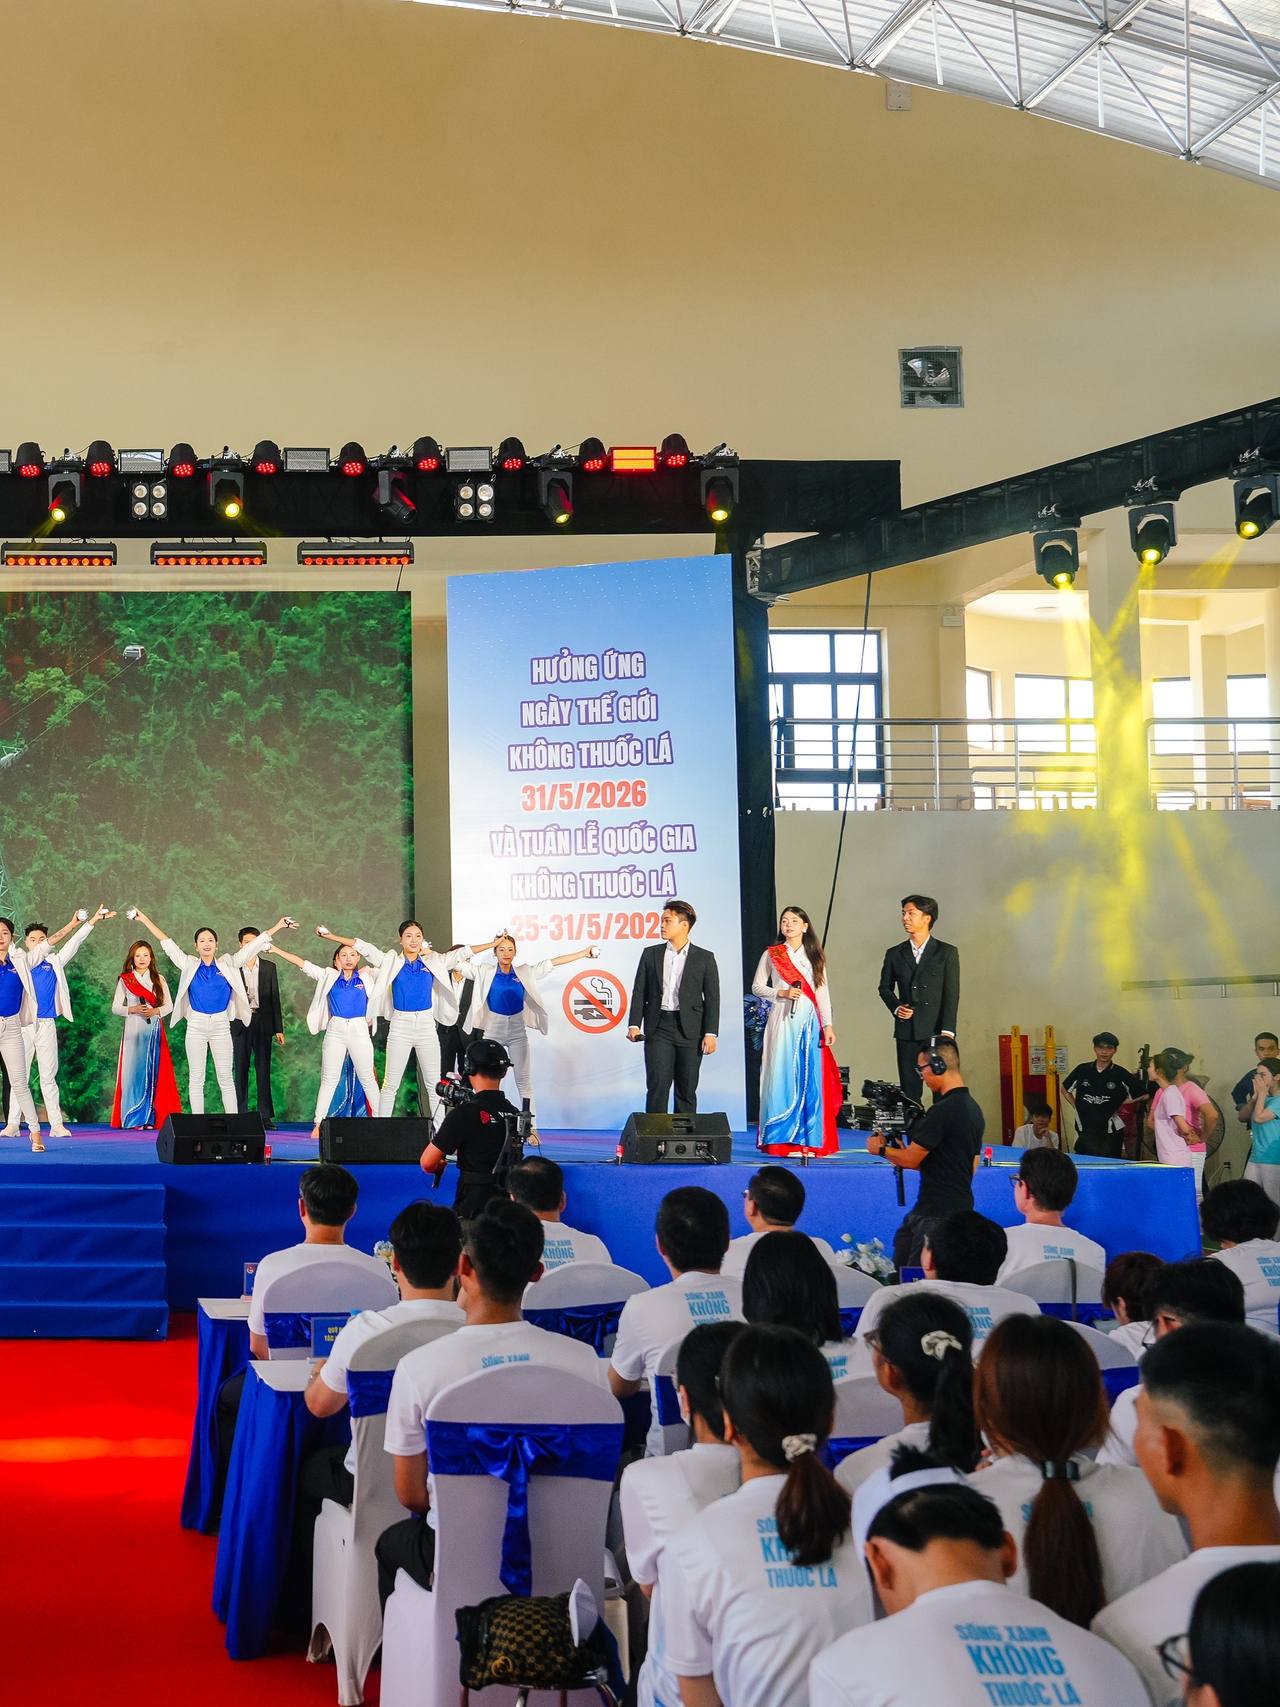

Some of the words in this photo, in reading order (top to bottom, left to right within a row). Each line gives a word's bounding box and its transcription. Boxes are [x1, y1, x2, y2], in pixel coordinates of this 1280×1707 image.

[531, 648, 598, 683] HƯỞNG
[603, 649, 645, 679] ỨNG
[521, 695, 572, 727] NGÀY
[576, 691, 617, 724] THẾ
[618, 688, 658, 722] GIỚI
[509, 738, 574, 770] KHÔNG
[578, 734, 643, 768] THUỐC
[647, 731, 672, 765] LÁ
[521, 779, 647, 812] 31/5/2026
[490, 825, 517, 857] VÀ
[521, 824, 570, 856] TUẦN
[575, 821, 599, 855] LỄ
[602, 821, 657, 857] QUỐC
[661, 825, 696, 852] GIA
[511, 867, 577, 900] KHÔNG
[581, 865, 645, 898] THUỐC
[650, 863, 676, 897] LÁ
[511, 912, 662, 942] 25-31/5/202
[543, 1246, 575, 1259] KHÔNG
[688, 1299, 730, 1317] KHÔNG
[965, 1642, 1066, 1676] KHÔNG
